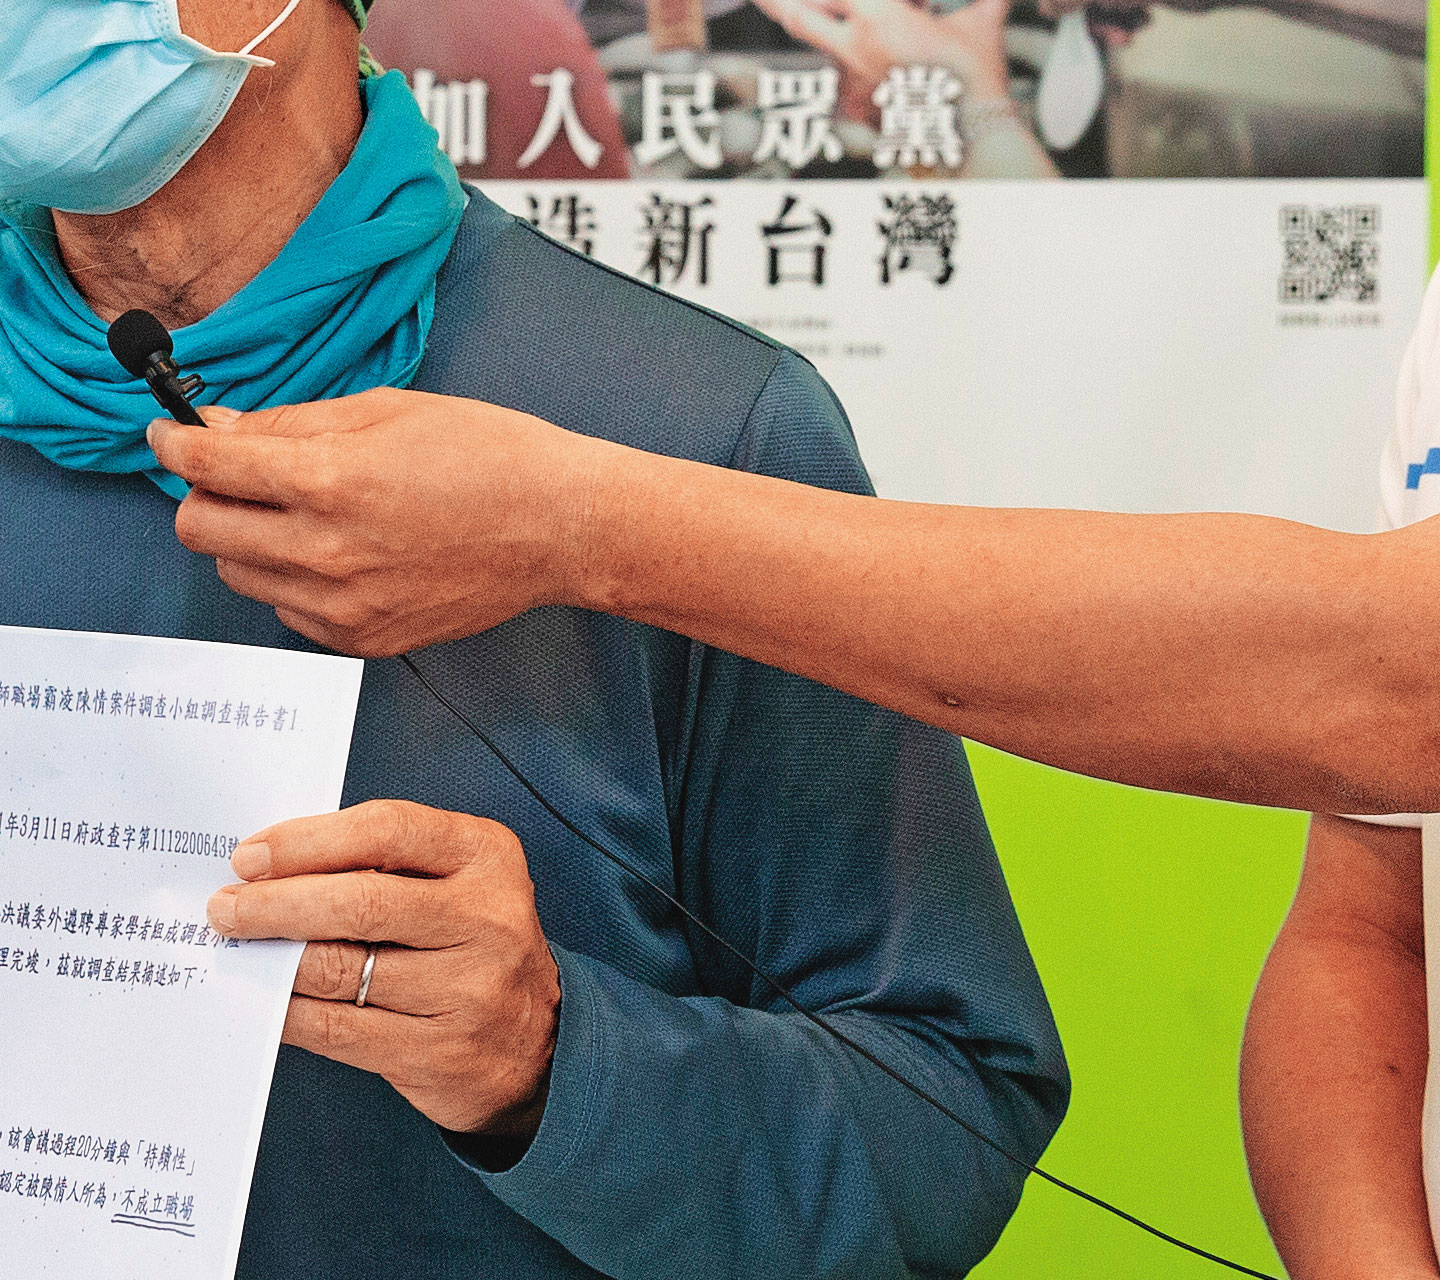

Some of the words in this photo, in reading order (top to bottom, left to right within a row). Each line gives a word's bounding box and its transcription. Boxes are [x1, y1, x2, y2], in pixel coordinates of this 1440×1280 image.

[412, 65, 966, 171] 加入民眾黨
